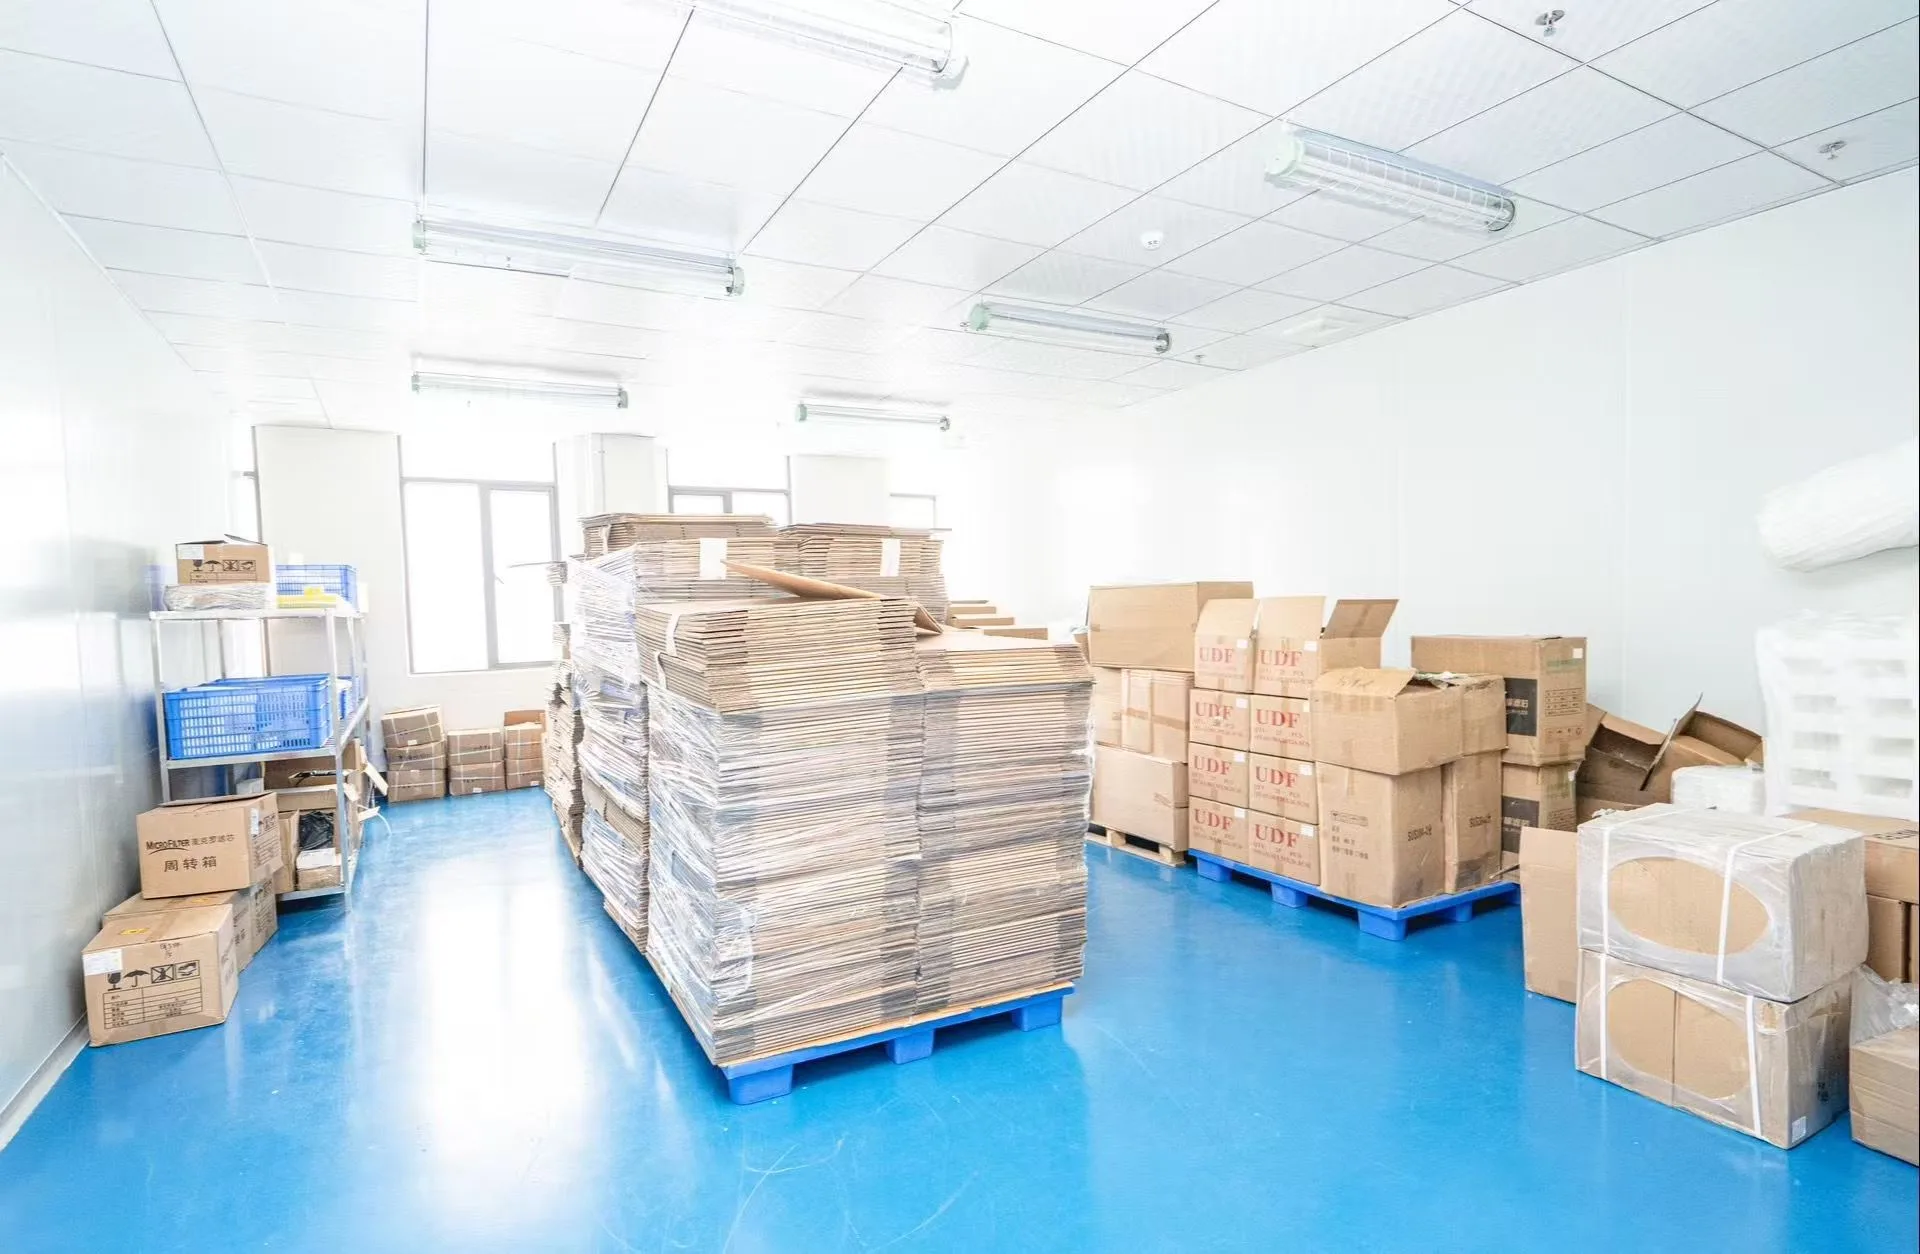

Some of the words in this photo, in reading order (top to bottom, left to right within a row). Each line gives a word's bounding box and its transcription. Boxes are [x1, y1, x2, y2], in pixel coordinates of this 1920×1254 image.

[1199, 647, 1235, 663] UDF
[1260, 649, 1302, 667] UDF
[1195, 702, 1233, 720] UDF
[1256, 709, 1300, 728] UDF
[1194, 755, 1232, 775] UDF
[1255, 766, 1299, 788] UDF
[1194, 808, 1233, 830] UDF
[1254, 824, 1300, 847] UDF
[164, 856, 217, 872] 周转箱
